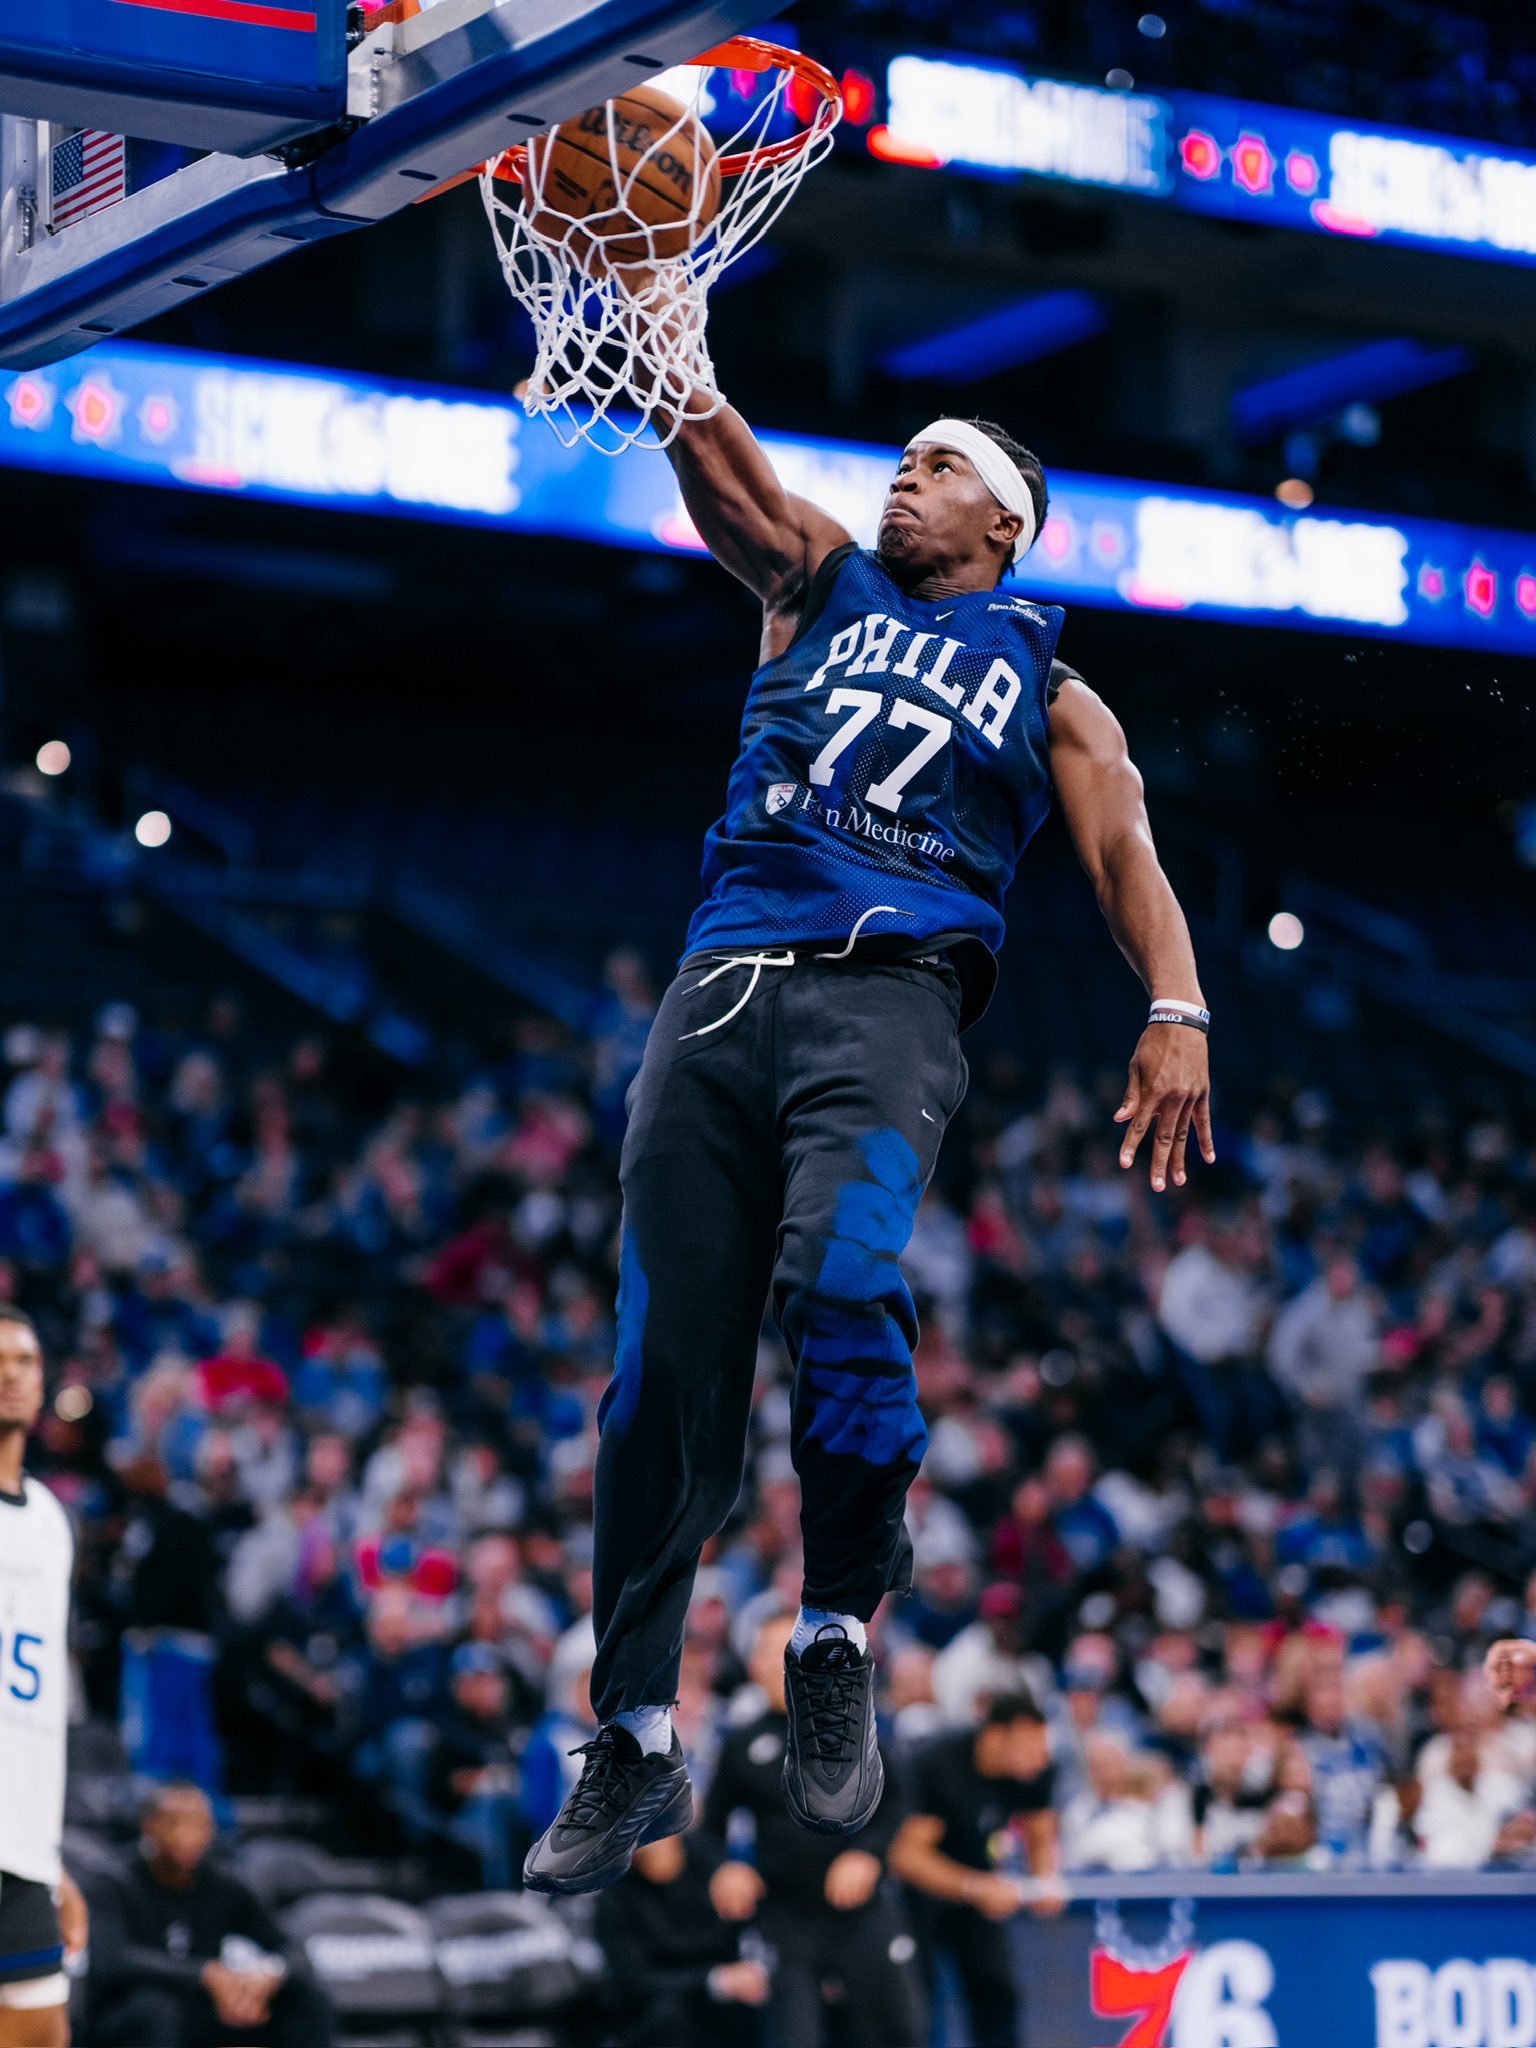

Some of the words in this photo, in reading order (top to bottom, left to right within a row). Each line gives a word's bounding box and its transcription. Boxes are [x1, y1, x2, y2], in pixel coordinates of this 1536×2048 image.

[1009, 604, 1047, 627] Medicine
[804, 613, 1022, 749] PHILA
[809, 688, 952, 813] 77
[843, 806, 955, 863] Medicine
[0, 1632, 43, 1701] 5
